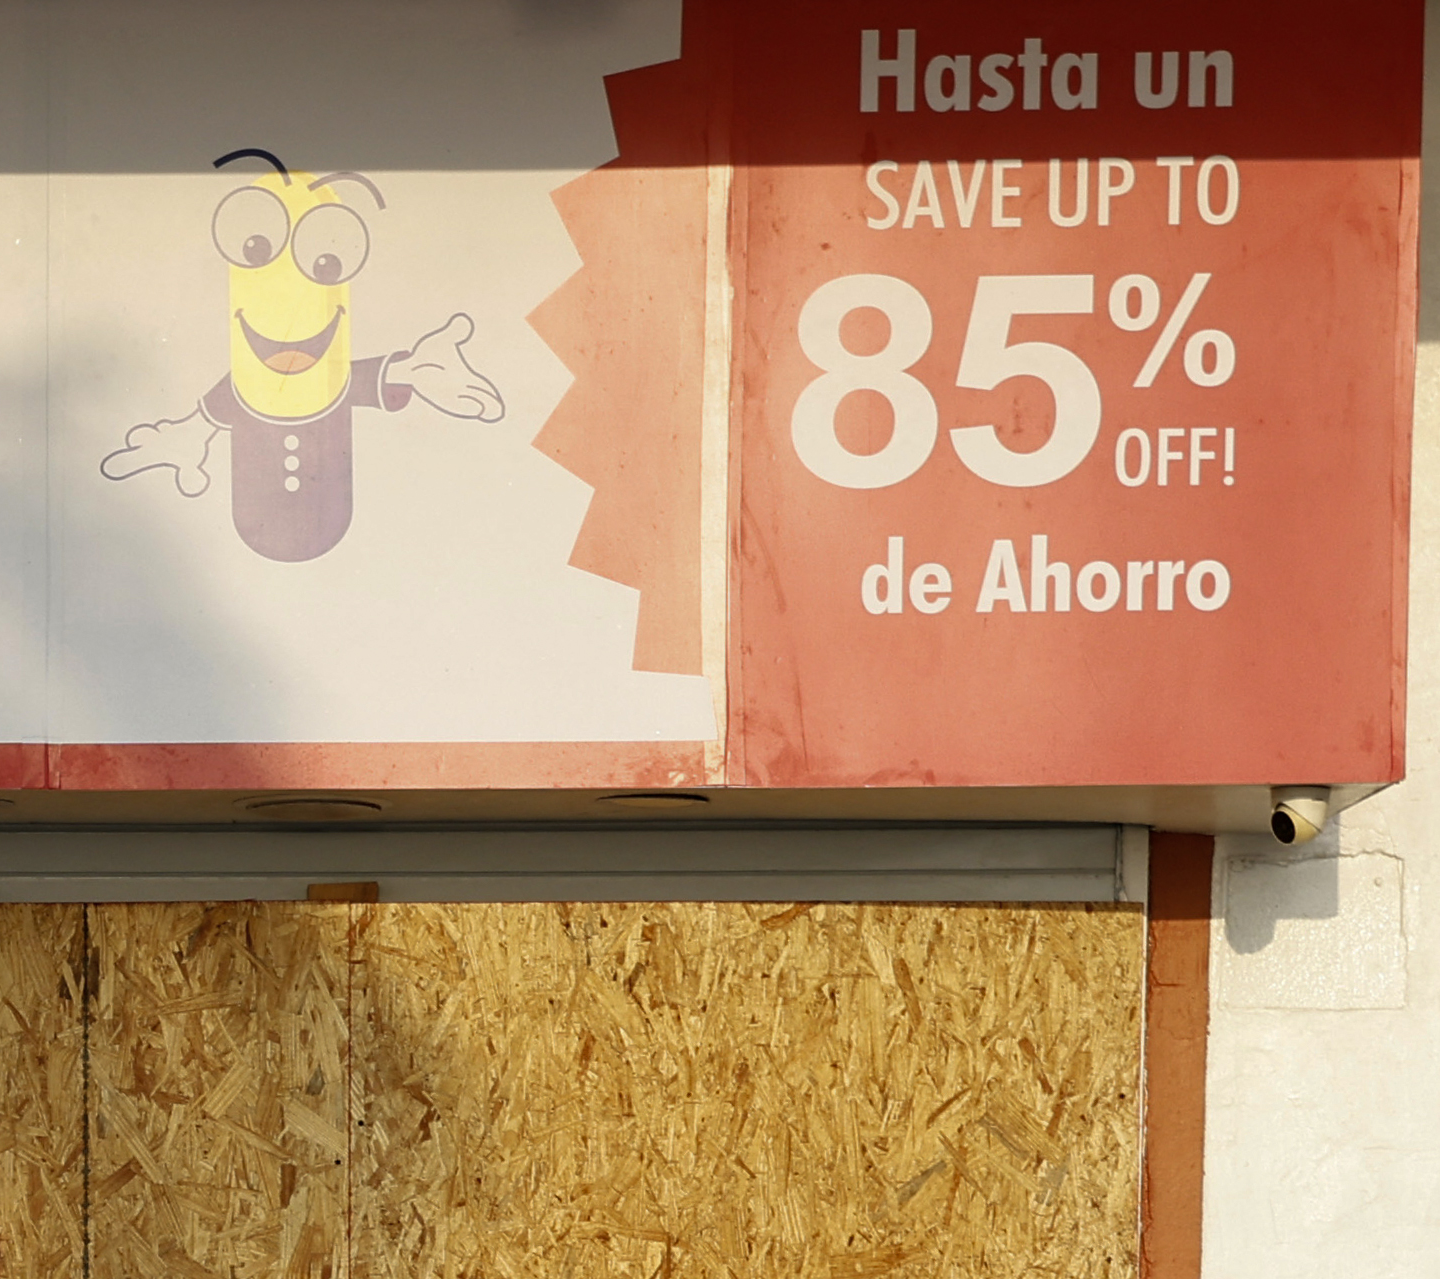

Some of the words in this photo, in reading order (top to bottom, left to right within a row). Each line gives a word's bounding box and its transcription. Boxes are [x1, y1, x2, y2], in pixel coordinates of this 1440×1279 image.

[859, 29, 1099, 114] Hasta
[1134, 46, 1235, 110] un
[865, 159, 1022, 231] SAVE
[1045, 157, 1137, 229] UP
[1156, 155, 1241, 228] TO
[789, 270, 1237, 490] 85%
[1113, 426, 1236, 488] OFF!
[860, 536, 953, 614] de
[976, 534, 1232, 613] Ahorro
